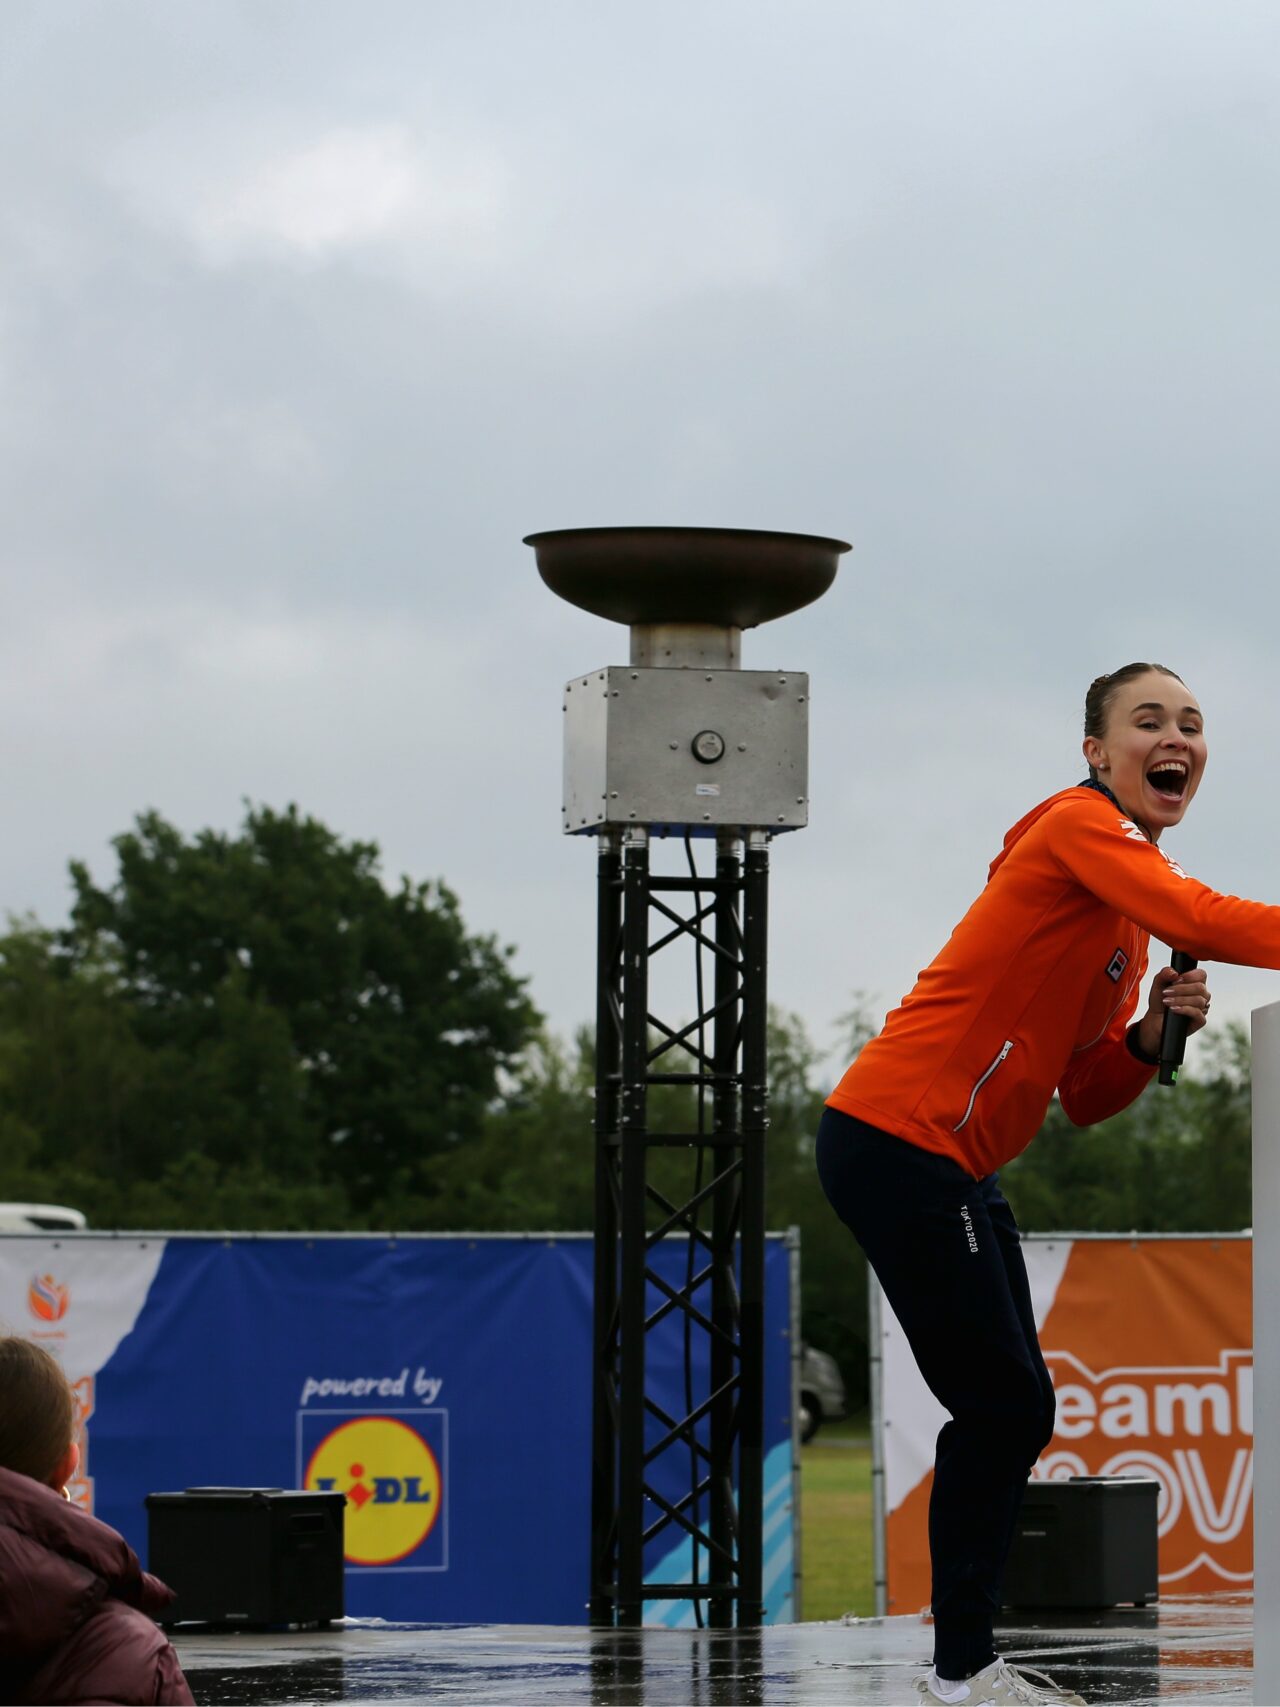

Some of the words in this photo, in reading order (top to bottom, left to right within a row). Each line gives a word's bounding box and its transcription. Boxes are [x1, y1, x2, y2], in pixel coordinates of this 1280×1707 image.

[960, 1204, 972, 1232] TOKYO
[966, 1231, 979, 1253] 2020
[301, 1368, 409, 1406] powered
[413, 1367, 442, 1405] by
[1049, 1366, 1254, 1440] eam
